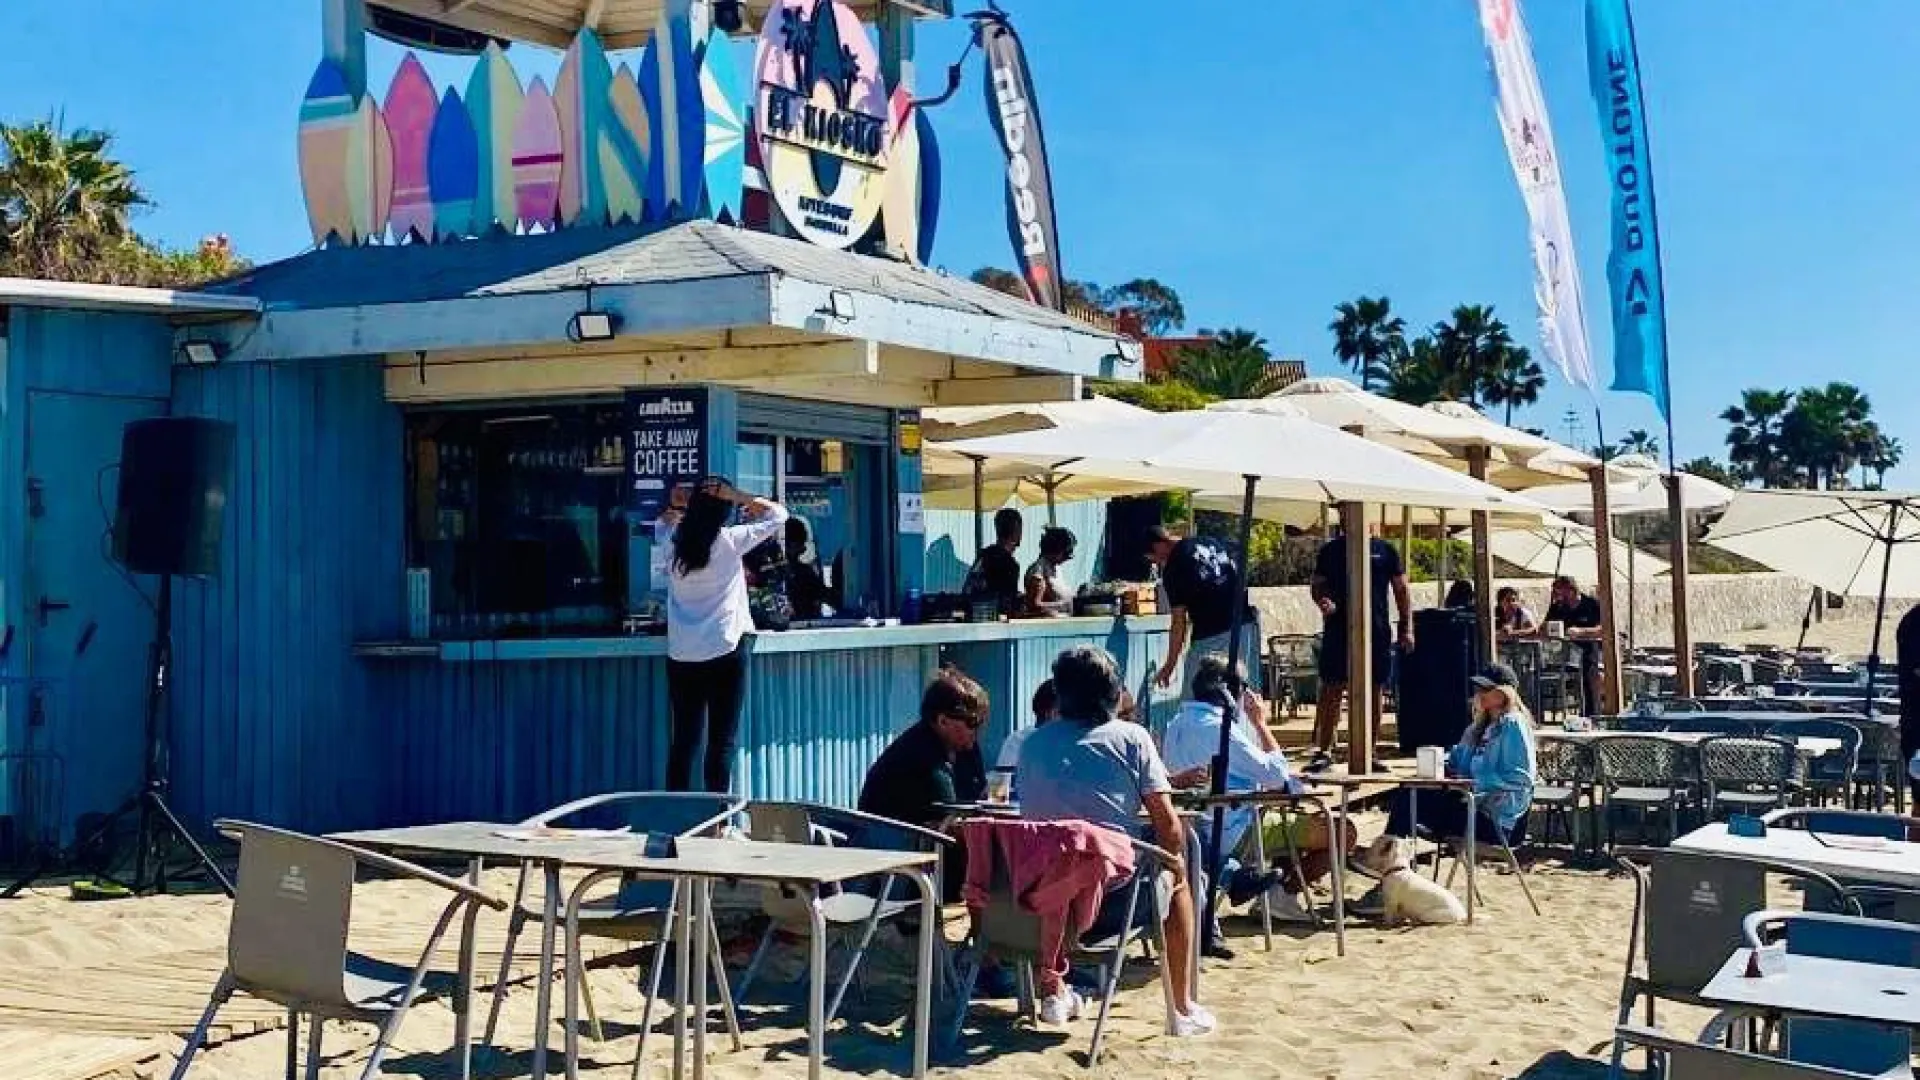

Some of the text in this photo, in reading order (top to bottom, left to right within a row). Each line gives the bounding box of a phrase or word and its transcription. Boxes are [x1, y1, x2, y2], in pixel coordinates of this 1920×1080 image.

[767, 88, 882, 157] EL KIOSKO
[633, 429, 699, 449] TAKE AWAY
[634, 448, 699, 474] COFFEE
